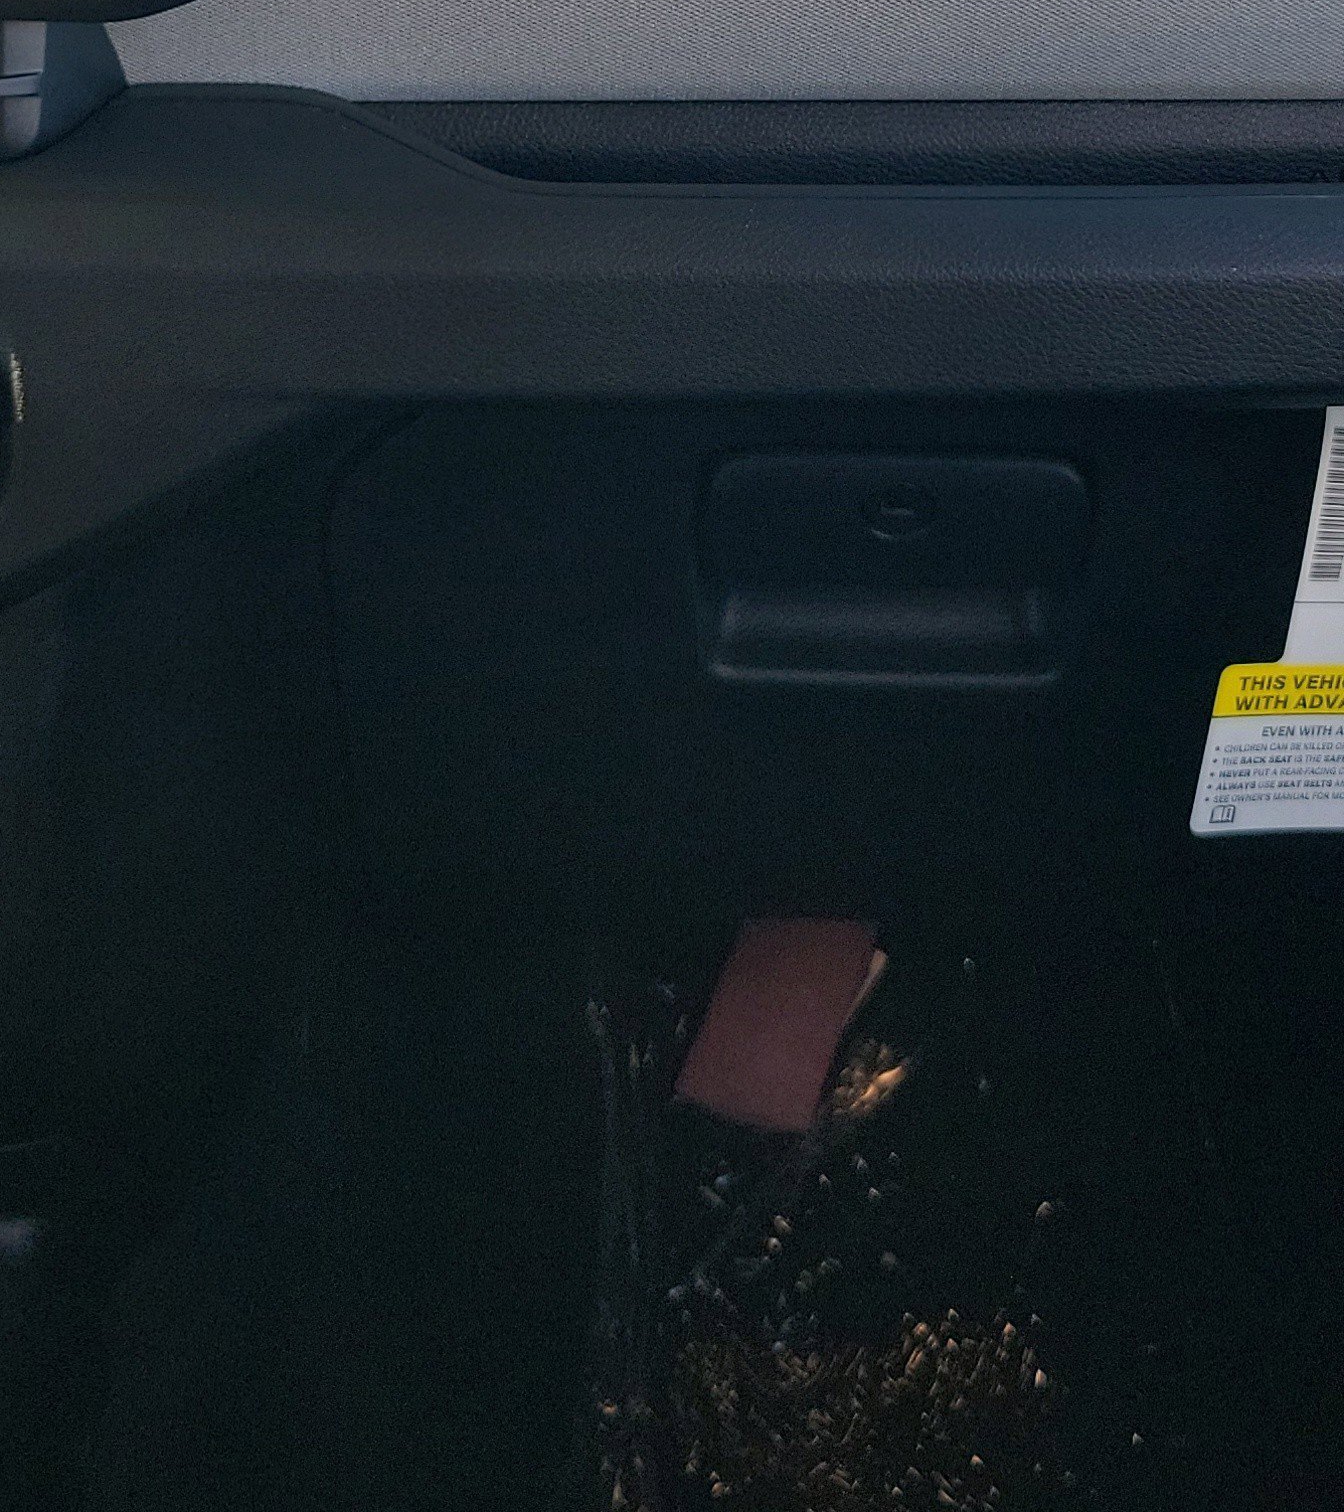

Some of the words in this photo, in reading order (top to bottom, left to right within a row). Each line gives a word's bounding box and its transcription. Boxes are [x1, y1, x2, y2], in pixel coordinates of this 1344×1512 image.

[1239, 674, 1287, 691] THIS
[1235, 694, 1289, 711] WITH
[1261, 725, 1296, 737] EVEN
[1299, 725, 1333, 736] WITH
[1216, 781, 1256, 790] ALWAYS
[1277, 779, 1302, 788] SEAT
[1303, 779, 1333, 788] BELTS
